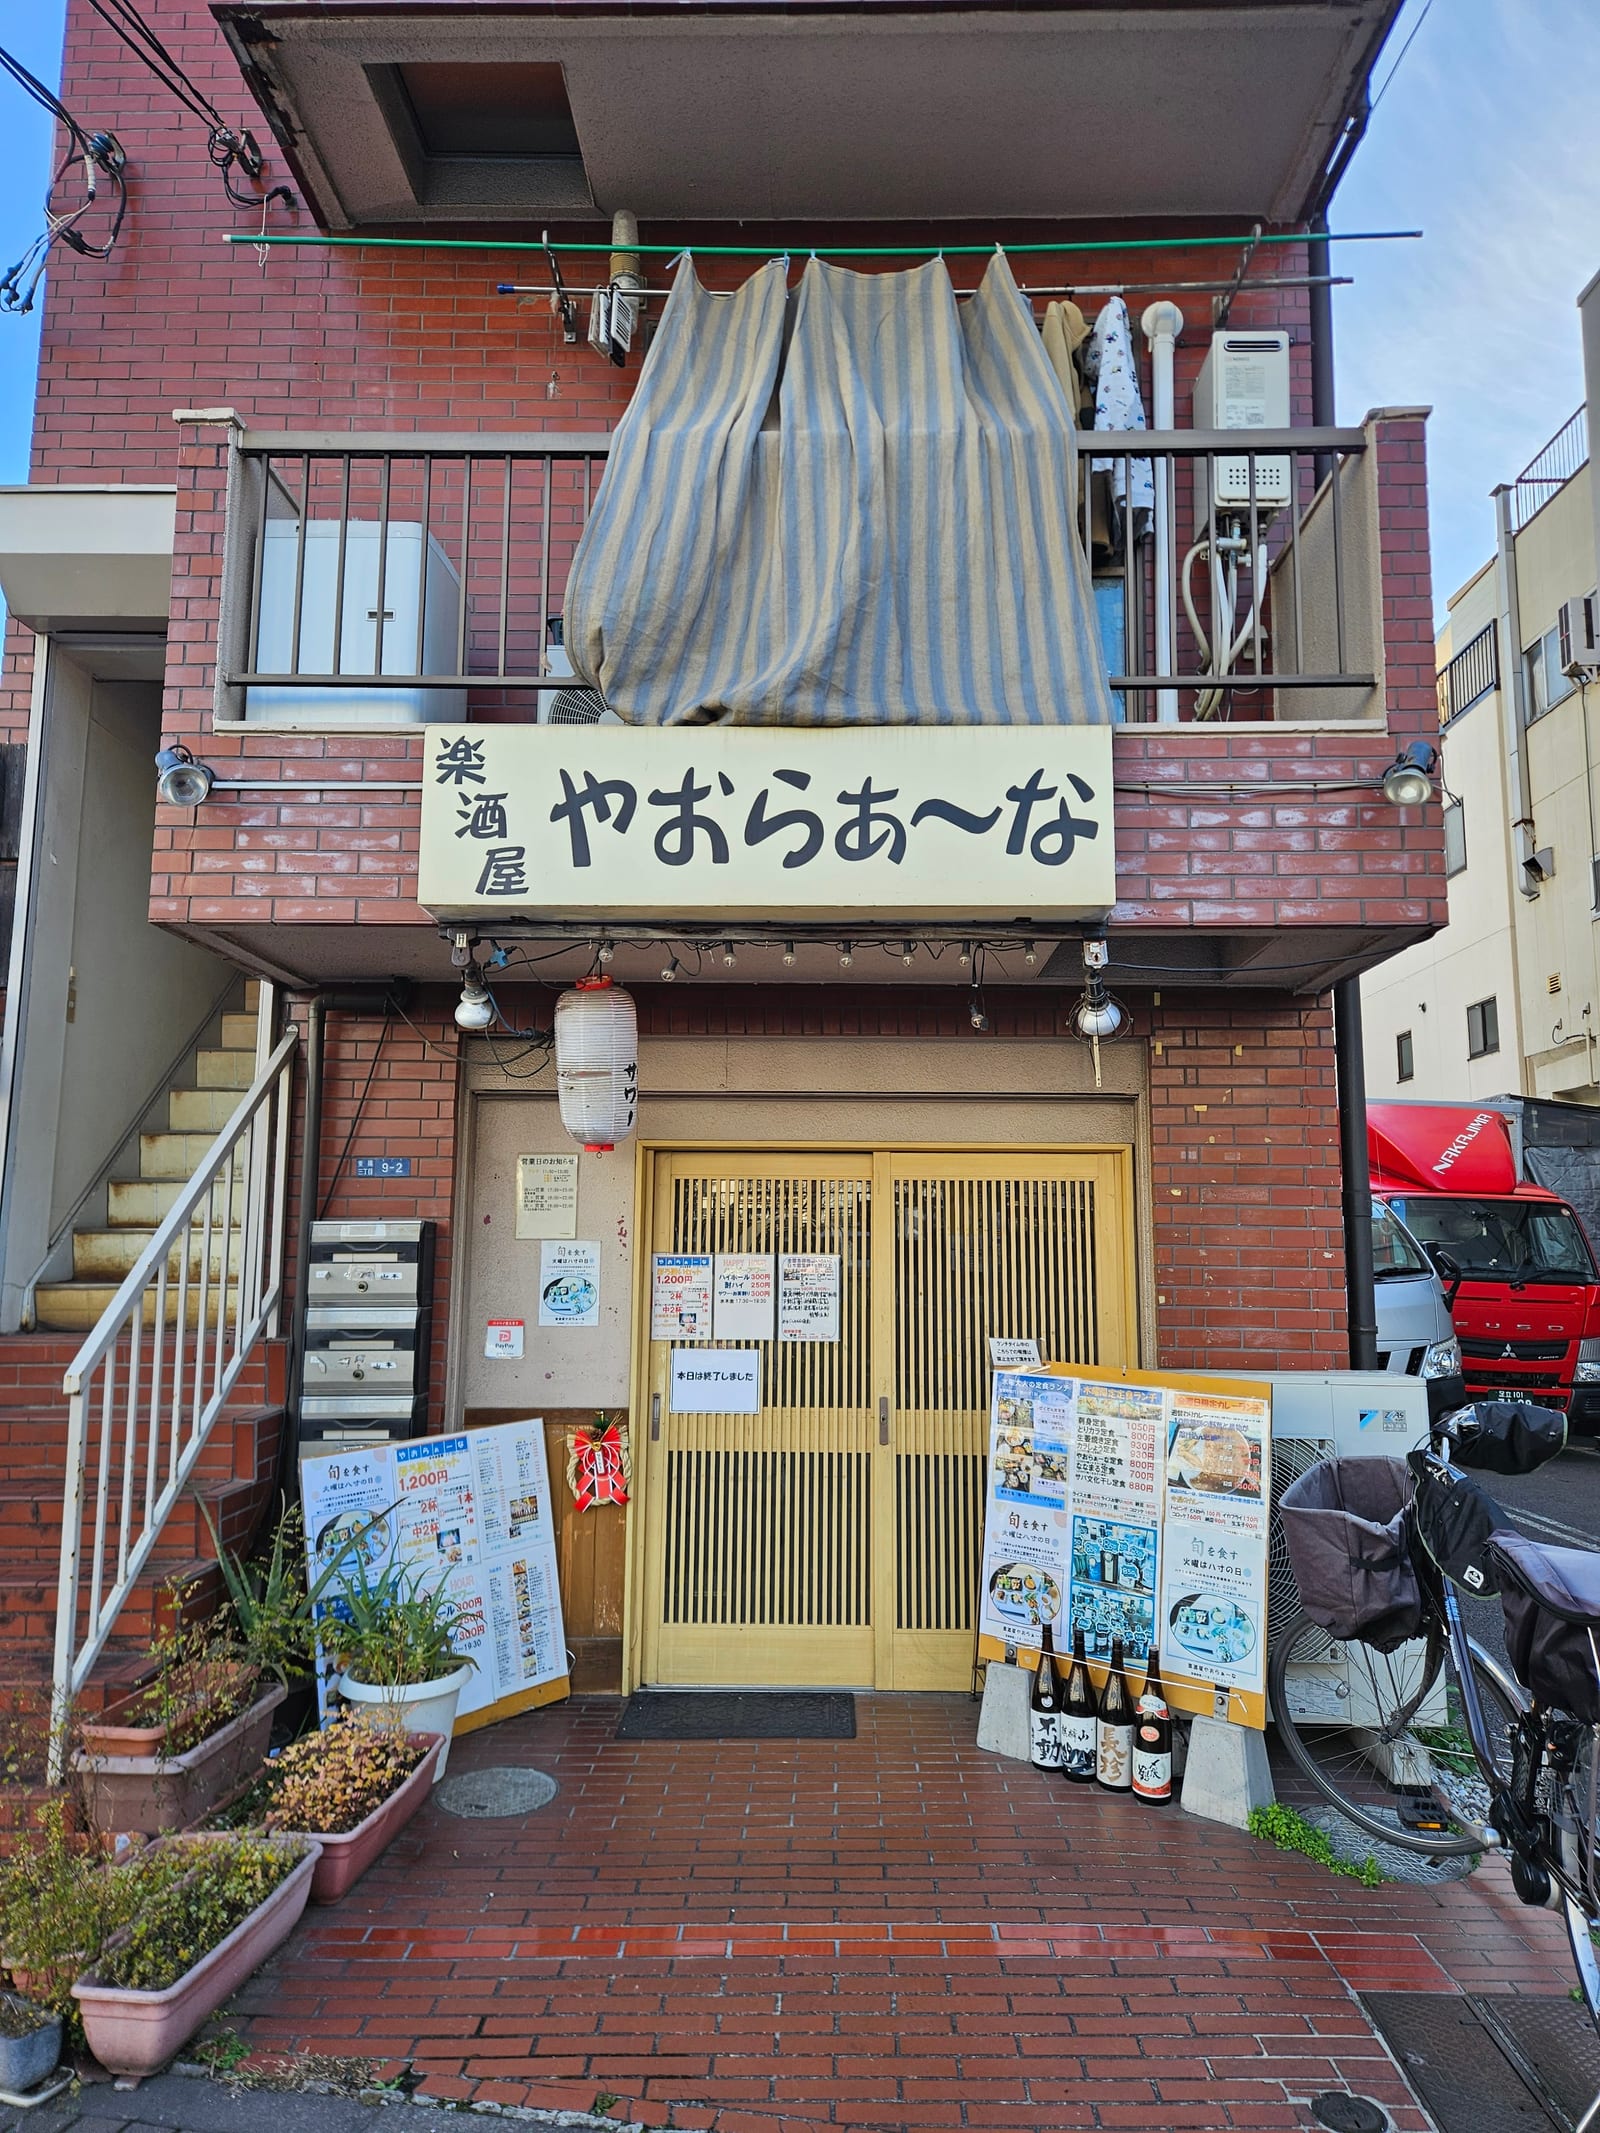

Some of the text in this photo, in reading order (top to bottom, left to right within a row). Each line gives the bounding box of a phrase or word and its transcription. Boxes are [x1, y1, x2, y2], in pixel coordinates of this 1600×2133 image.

[436, 735, 529, 896] 楽酒屋
[624, 1062, 638, 1126] サワー
[1432, 1113, 1493, 1175] NAKAJIMA
[382, 1162, 403, 1174] 9-2
[657, 1276, 692, 1284] 1,200円
[1455, 1321, 1564, 1331] FUSO
[677, 1371, 753, 1381] 本日は終了しました
[1078, 1417, 1155, 1433] 刺身定食 1050円
[1131, 1432, 1155, 1443] 800円
[399, 1440, 465, 1459] やおらぁーな
[1130, 1441, 1155, 1452] 930円
[1130, 1450, 1155, 1460] 930円
[328, 1464, 369, 1480] 旬を食す
[1129, 1460, 1155, 1471] 800円
[399, 1470, 448, 1491] 1,200円
[1129, 1470, 1154, 1481] 700円
[322, 1477, 373, 1493] 火曜は八寸の日
[1128, 1482, 1154, 1493] 880円
[458, 1491, 473, 1505] 1本
[421, 1500, 438, 1513] 2杯
[1009, 1511, 1048, 1531] 旬を食す
[413, 1523, 440, 1538] 中2杯
[1002, 1531, 1050, 1545] 火曜は八寸の日
[1191, 1536, 1238, 1560] 旬を食す
[1183, 1557, 1242, 1577] 火曜は八寸の日
[459, 1625, 485, 1641] 300円
[1035, 1717, 1062, 1763] 不動
